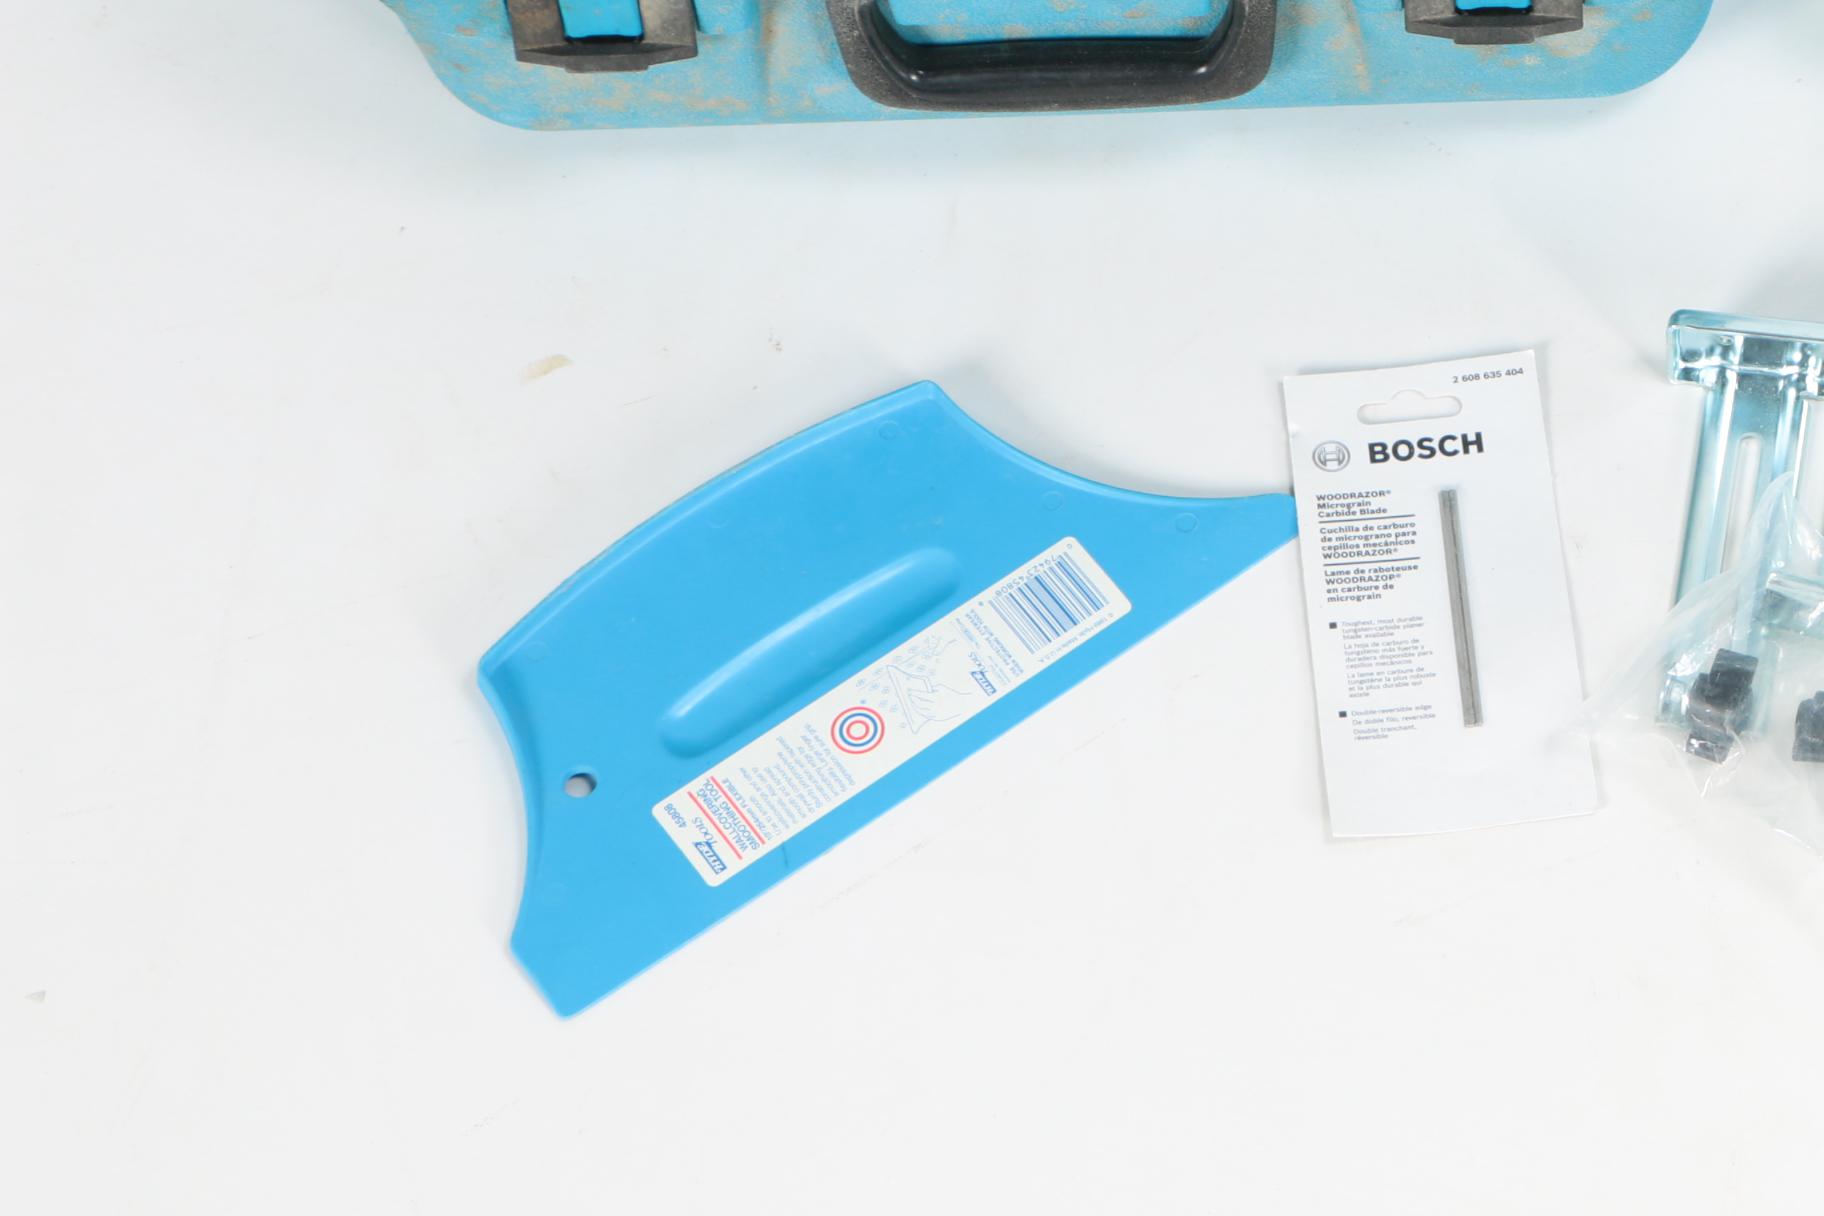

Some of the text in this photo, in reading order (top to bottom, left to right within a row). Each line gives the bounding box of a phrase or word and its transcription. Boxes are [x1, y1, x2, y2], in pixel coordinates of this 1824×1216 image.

[1452, 367, 1524, 384] 2 608 635 404
[1368, 432, 1485, 464] BOSCH
[1317, 500, 1372, 510] Micrograin
[1318, 507, 1388, 518] Carbide Blade
[1320, 522, 1416, 534] Cuchilla de carburo
[1321, 530, 1417, 544] de micrograno para
[1321, 538, 1416, 552] cepillos mecánicos
[1324, 564, 1419, 577] Lame de raboteuse
[1326, 587, 1339, 595] en
[1341, 584, 1380, 593] carbure
[1327, 593, 1382, 603] micrograin
[721, 777, 748, 809] FLEXIBLE
[662, 801, 688, 830] 45808
[694, 787, 749, 853] WALLCOVERING
[700, 777, 760, 851] SMOOTHING TOOL
